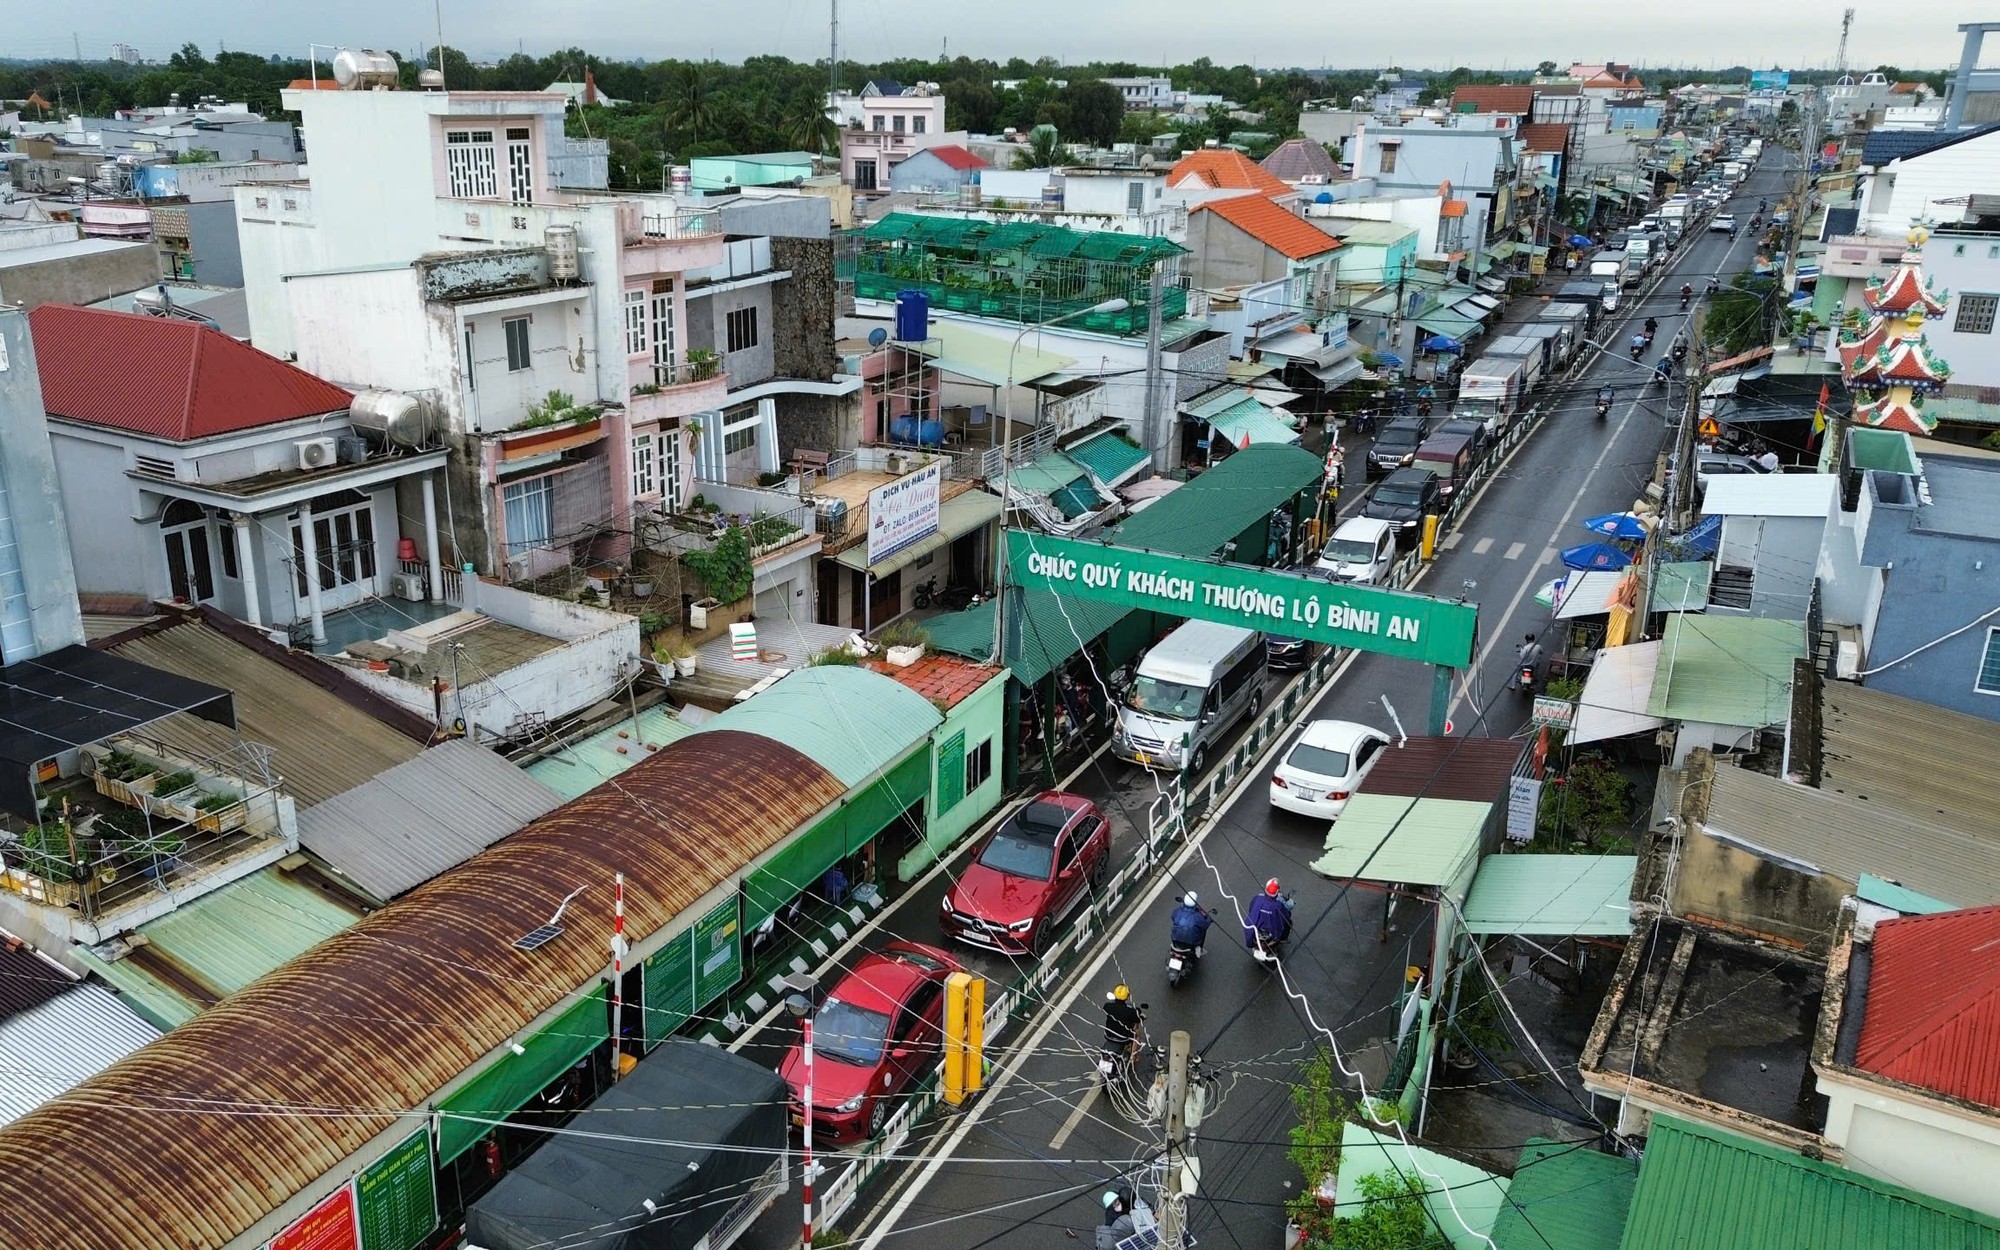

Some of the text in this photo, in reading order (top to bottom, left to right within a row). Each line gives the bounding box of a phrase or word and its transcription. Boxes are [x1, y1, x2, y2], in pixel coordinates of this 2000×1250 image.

[1028, 552, 1420, 643] CHÚC QUÝ KHÁCH THƯỢNG LỘ BÌNH AN
